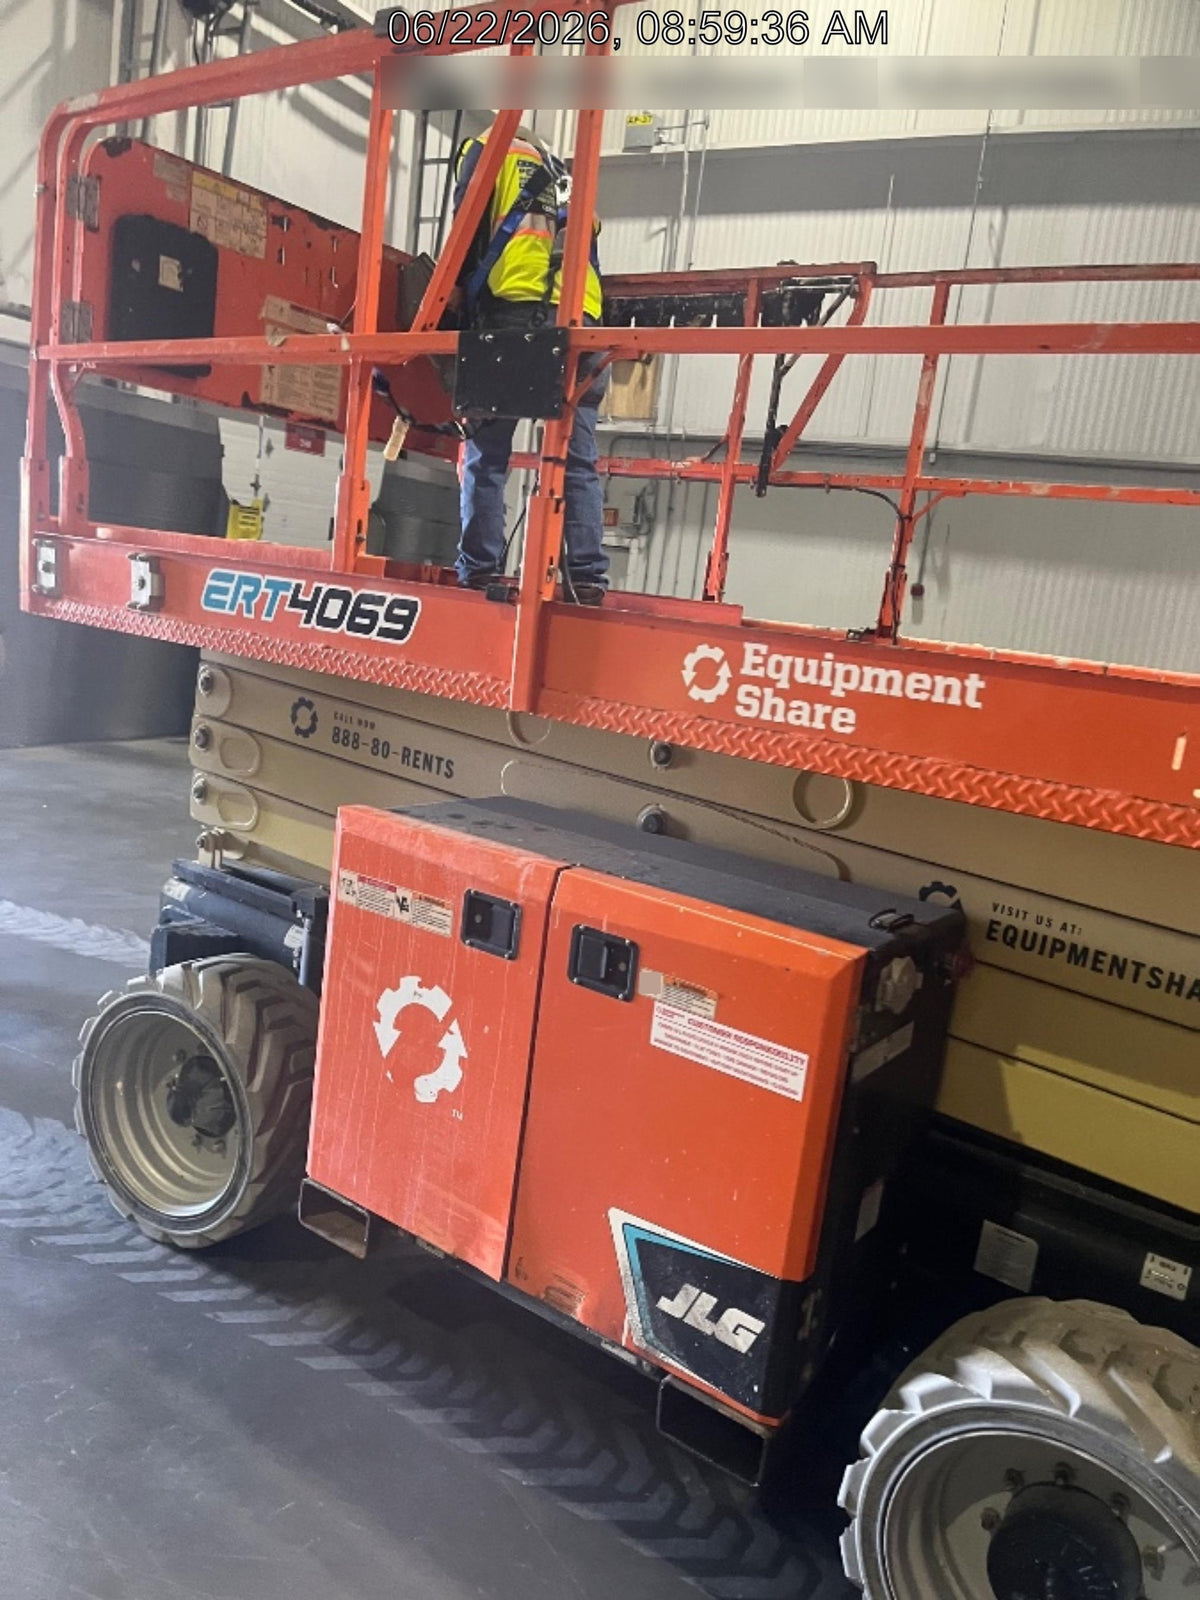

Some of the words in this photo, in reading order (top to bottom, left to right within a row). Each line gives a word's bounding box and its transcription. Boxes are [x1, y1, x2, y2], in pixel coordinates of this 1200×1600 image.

[203, 571, 418, 643] ERT4069
[741, 642, 984, 709] Equipment
[735, 684, 856, 734] Share
[332, 726, 454, 779] 888-80-RENTS
[991, 902, 1029, 920] VISIT
[1036, 915, 1053, 928] US
[655, 1283, 765, 1354] JLG
